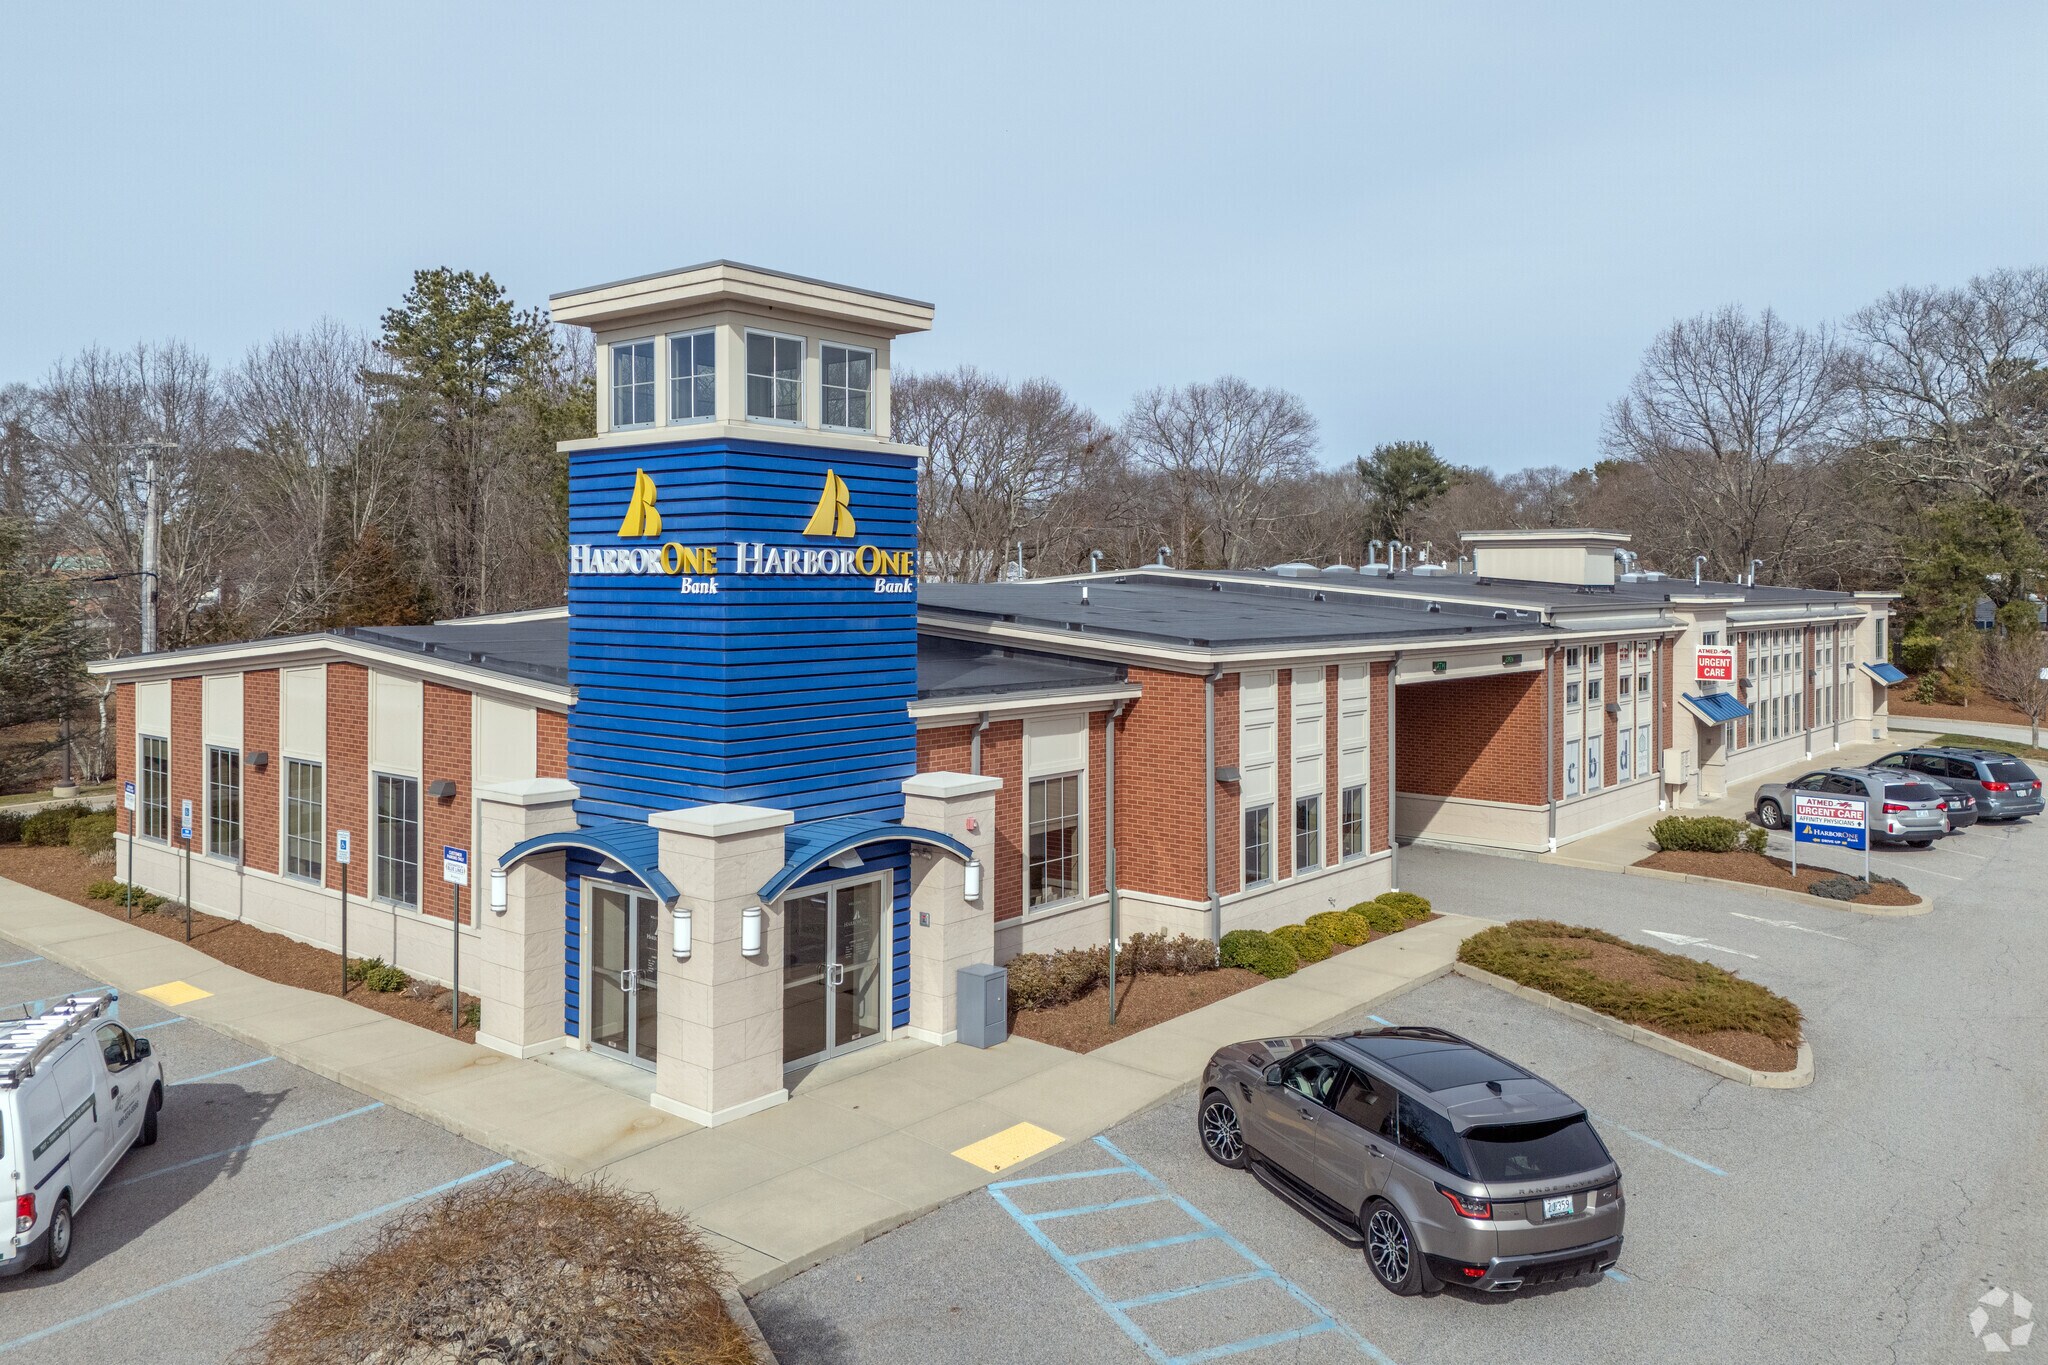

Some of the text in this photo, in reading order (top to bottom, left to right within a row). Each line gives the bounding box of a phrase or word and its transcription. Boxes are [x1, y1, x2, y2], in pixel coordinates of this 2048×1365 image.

[680, 577, 719, 595] Bank
[873, 577, 913, 594] Bank
[1698, 657, 1731, 667] URGENT
[1703, 667, 1726, 677] CARE
[1798, 806, 1863, 820] URGENT CARE
[1824, 818, 1854, 826] PHYSICIANS
[1518, 1179, 1599, 1195] RANGE ROVER
